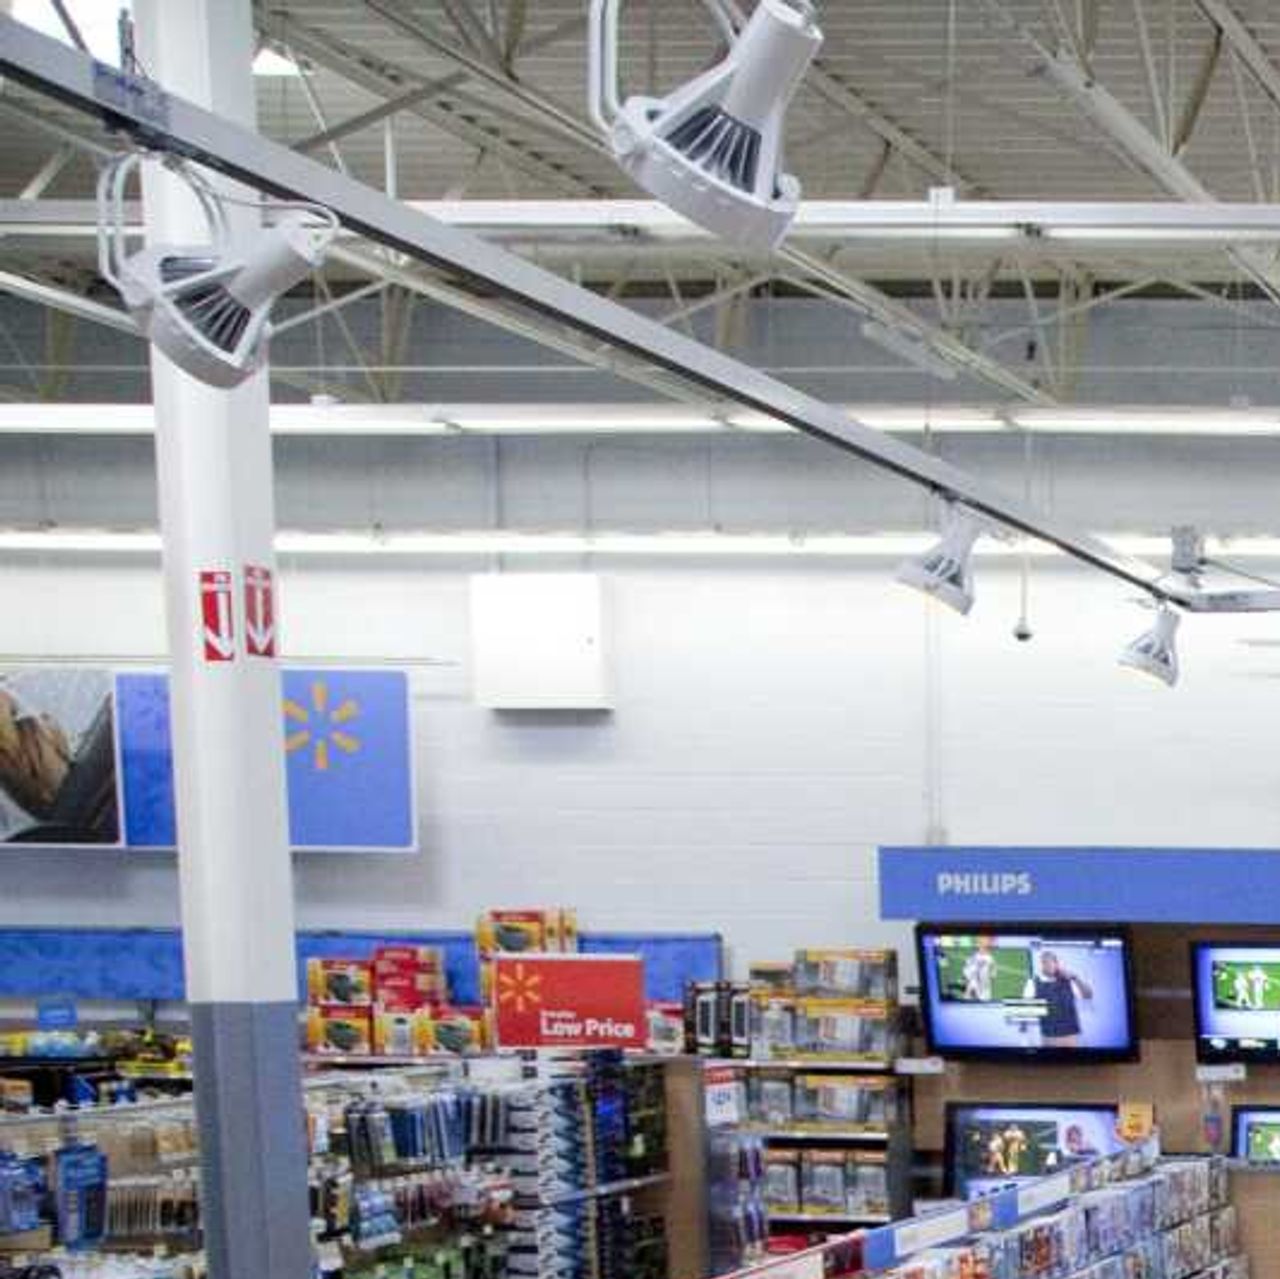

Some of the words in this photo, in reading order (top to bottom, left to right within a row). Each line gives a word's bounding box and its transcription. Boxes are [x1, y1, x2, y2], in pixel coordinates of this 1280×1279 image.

[936, 871, 1032, 895] PHILIPS
[539, 1014, 583, 1037] Low
[584, 1016, 636, 1038] Price
